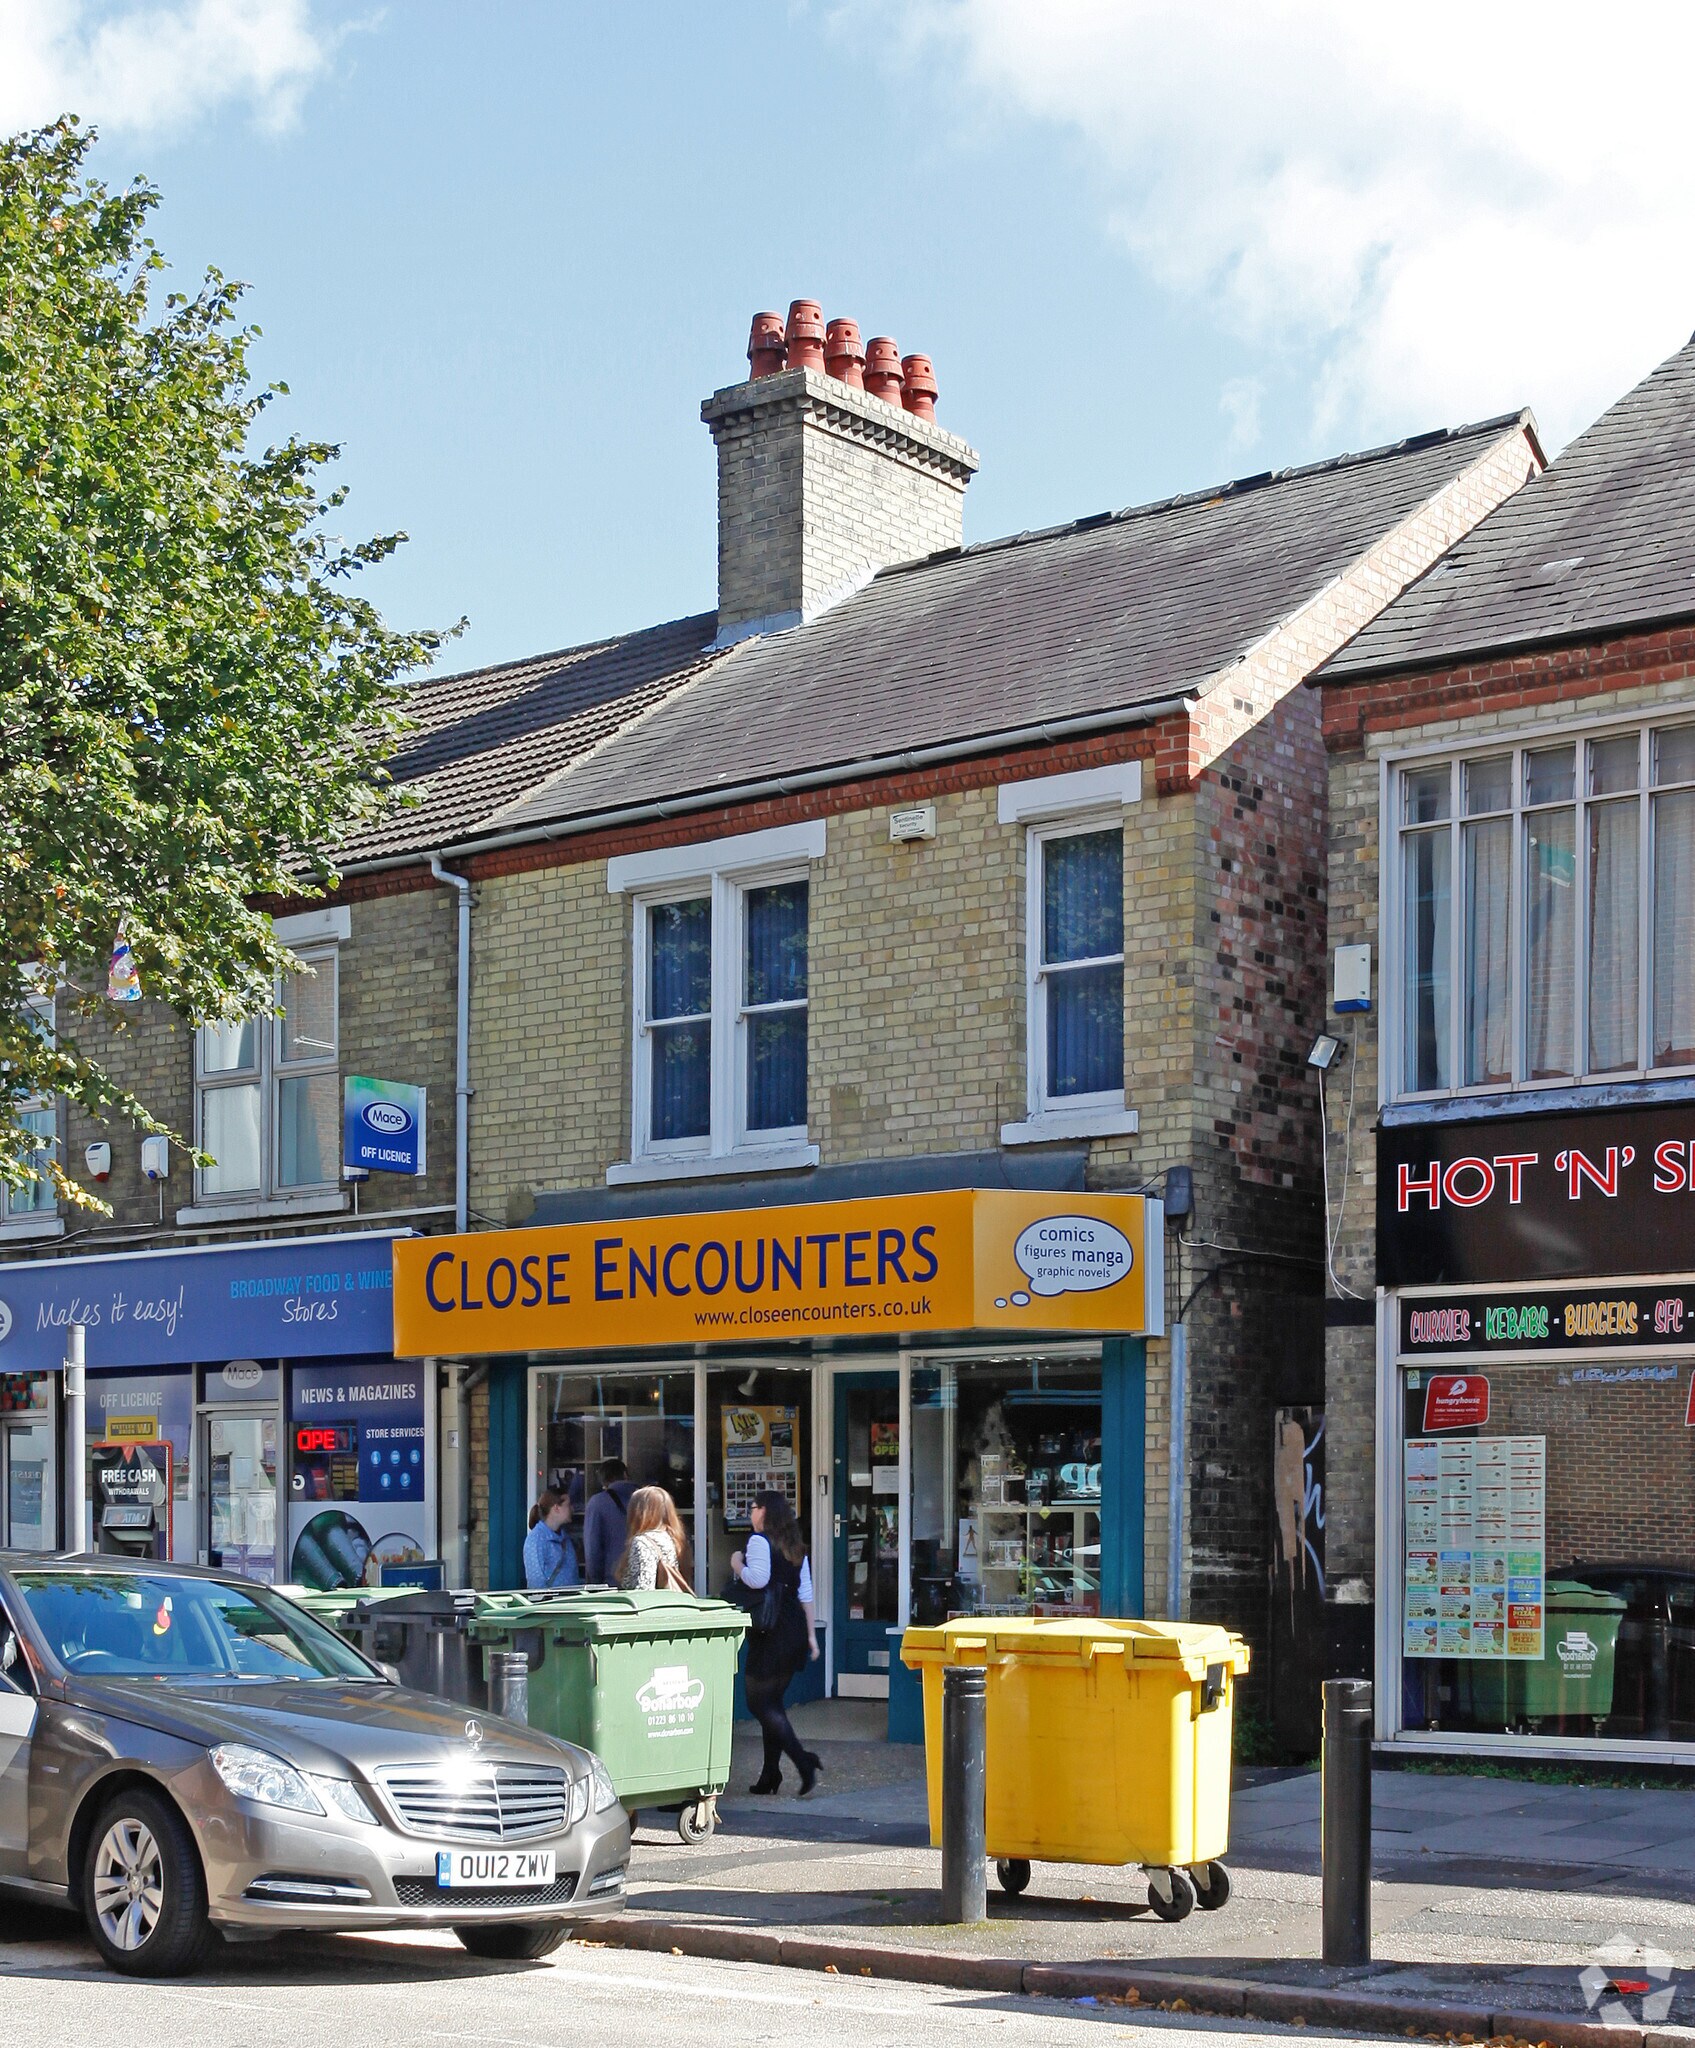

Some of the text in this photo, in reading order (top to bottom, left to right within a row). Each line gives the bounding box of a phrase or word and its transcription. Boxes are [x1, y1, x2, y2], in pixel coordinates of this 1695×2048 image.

[372, 1110, 403, 1126] Mace
[361, 1146, 412, 1165] OFF LICENCE
[1397, 1153, 1539, 1212] HOT
[1039, 1226, 1095, 1243] comics
[1024, 1244, 1124, 1267] figures manga
[426, 1224, 940, 1313] CLOSE ENCOUNTERS
[1037, 1266, 1111, 1279] graphic novels
[229, 1275, 302, 1300] BROADWAY
[305, 1272, 341, 1295] FOOD
[344, 1272, 355, 1292] &
[36, 1295, 101, 1333] Makes
[111, 1292, 128, 1324] it
[133, 1285, 186, 1337] easy!
[281, 1296, 339, 1324] Stores
[694, 1296, 933, 1328] www.closeencounters.co.uk
[1410, 1297, 1684, 1344] CURRIES KEBABS BURGERS SFC
[227, 1366, 259, 1381] Mace
[99, 1391, 163, 1408] OFF LICENCE
[301, 1383, 417, 1404] NEWS & MAGAZINES
[1435, 1396, 1481, 1406] hungryhouse
[366, 1426, 425, 1439] STORE SERVICES
[101, 1468, 157, 1483] FREE CASH
[108, 1487, 150, 1496] WITHDRAWALS
[647, 1715, 666, 1726] 01223
[460, 1854, 550, 1879] OU12 ZWV
